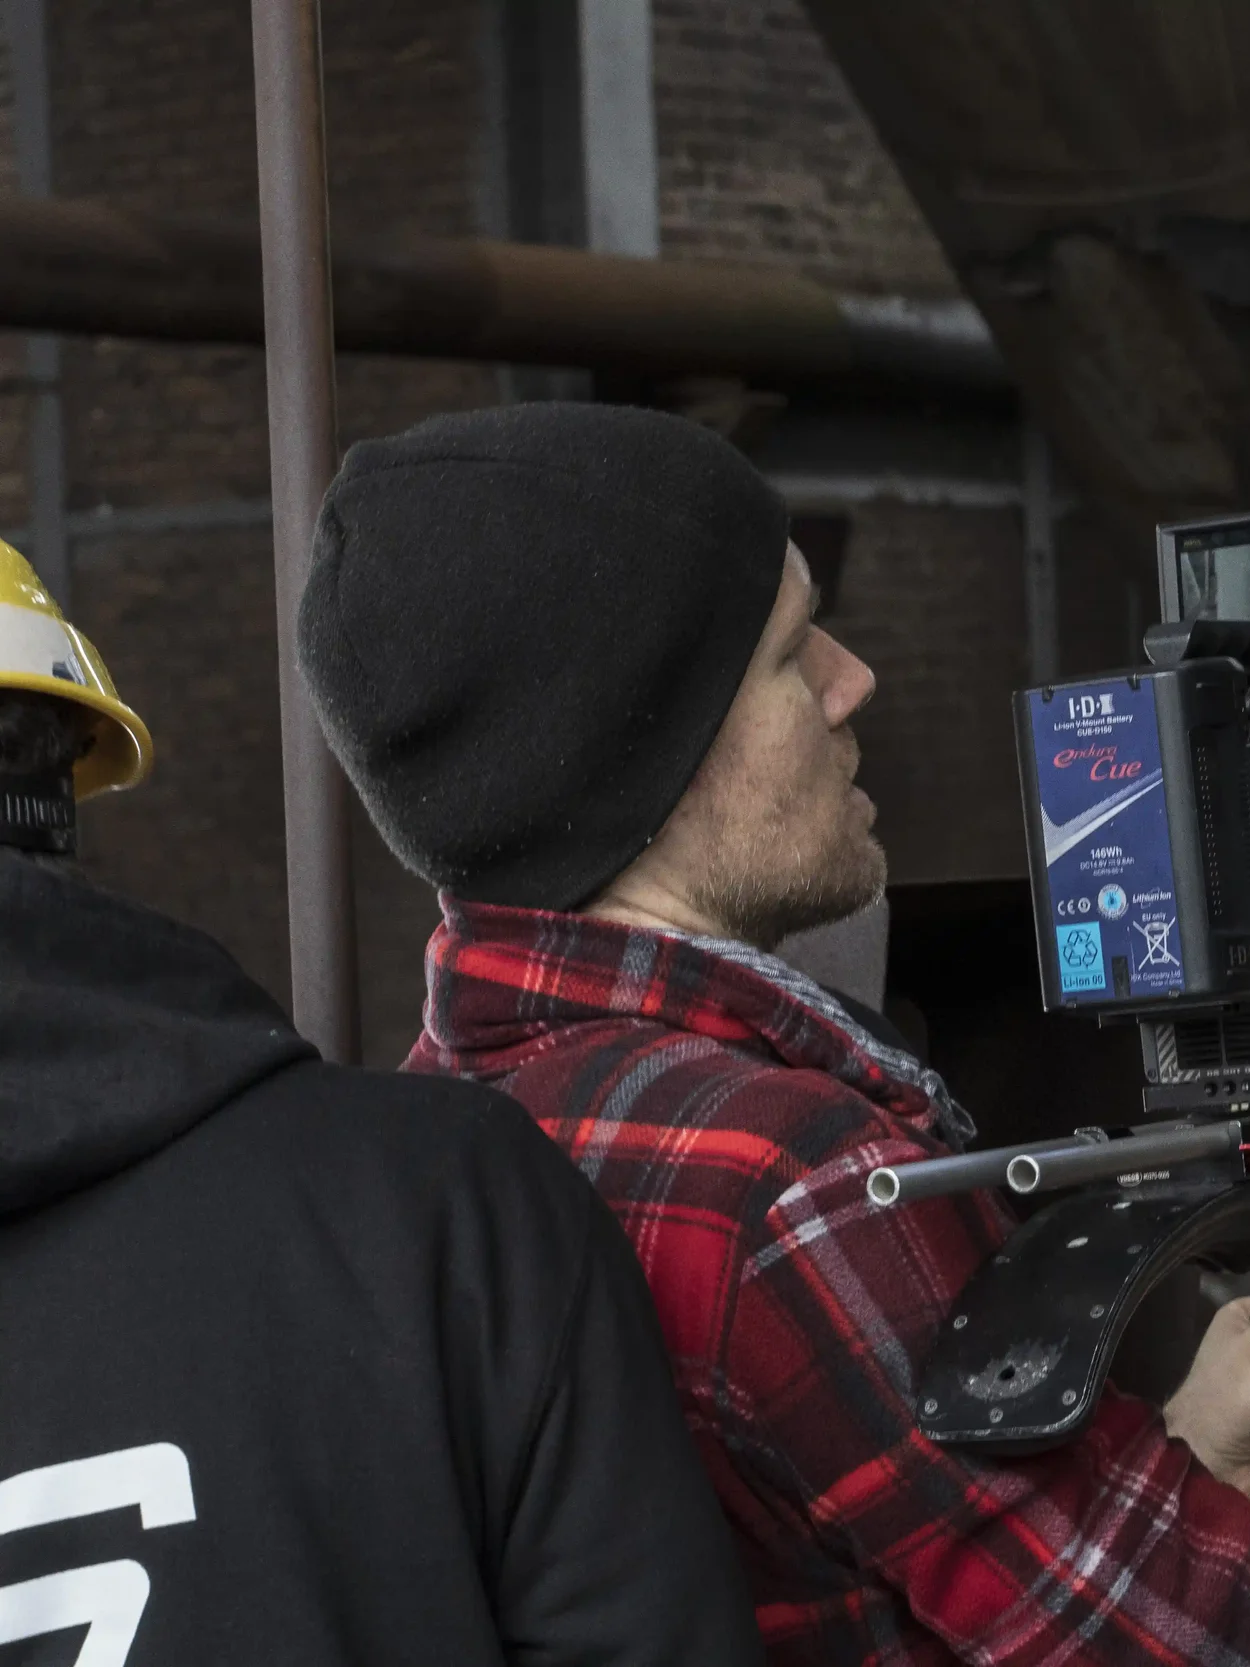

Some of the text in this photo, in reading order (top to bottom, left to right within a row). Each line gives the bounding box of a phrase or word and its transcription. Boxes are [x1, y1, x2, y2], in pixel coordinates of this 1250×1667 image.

[1106, 714, 1134, 725] Battery
[1090, 756, 1142, 781] Cue
[1090, 846, 1123, 860] 146Wh
[1142, 913, 1151, 922] EU
